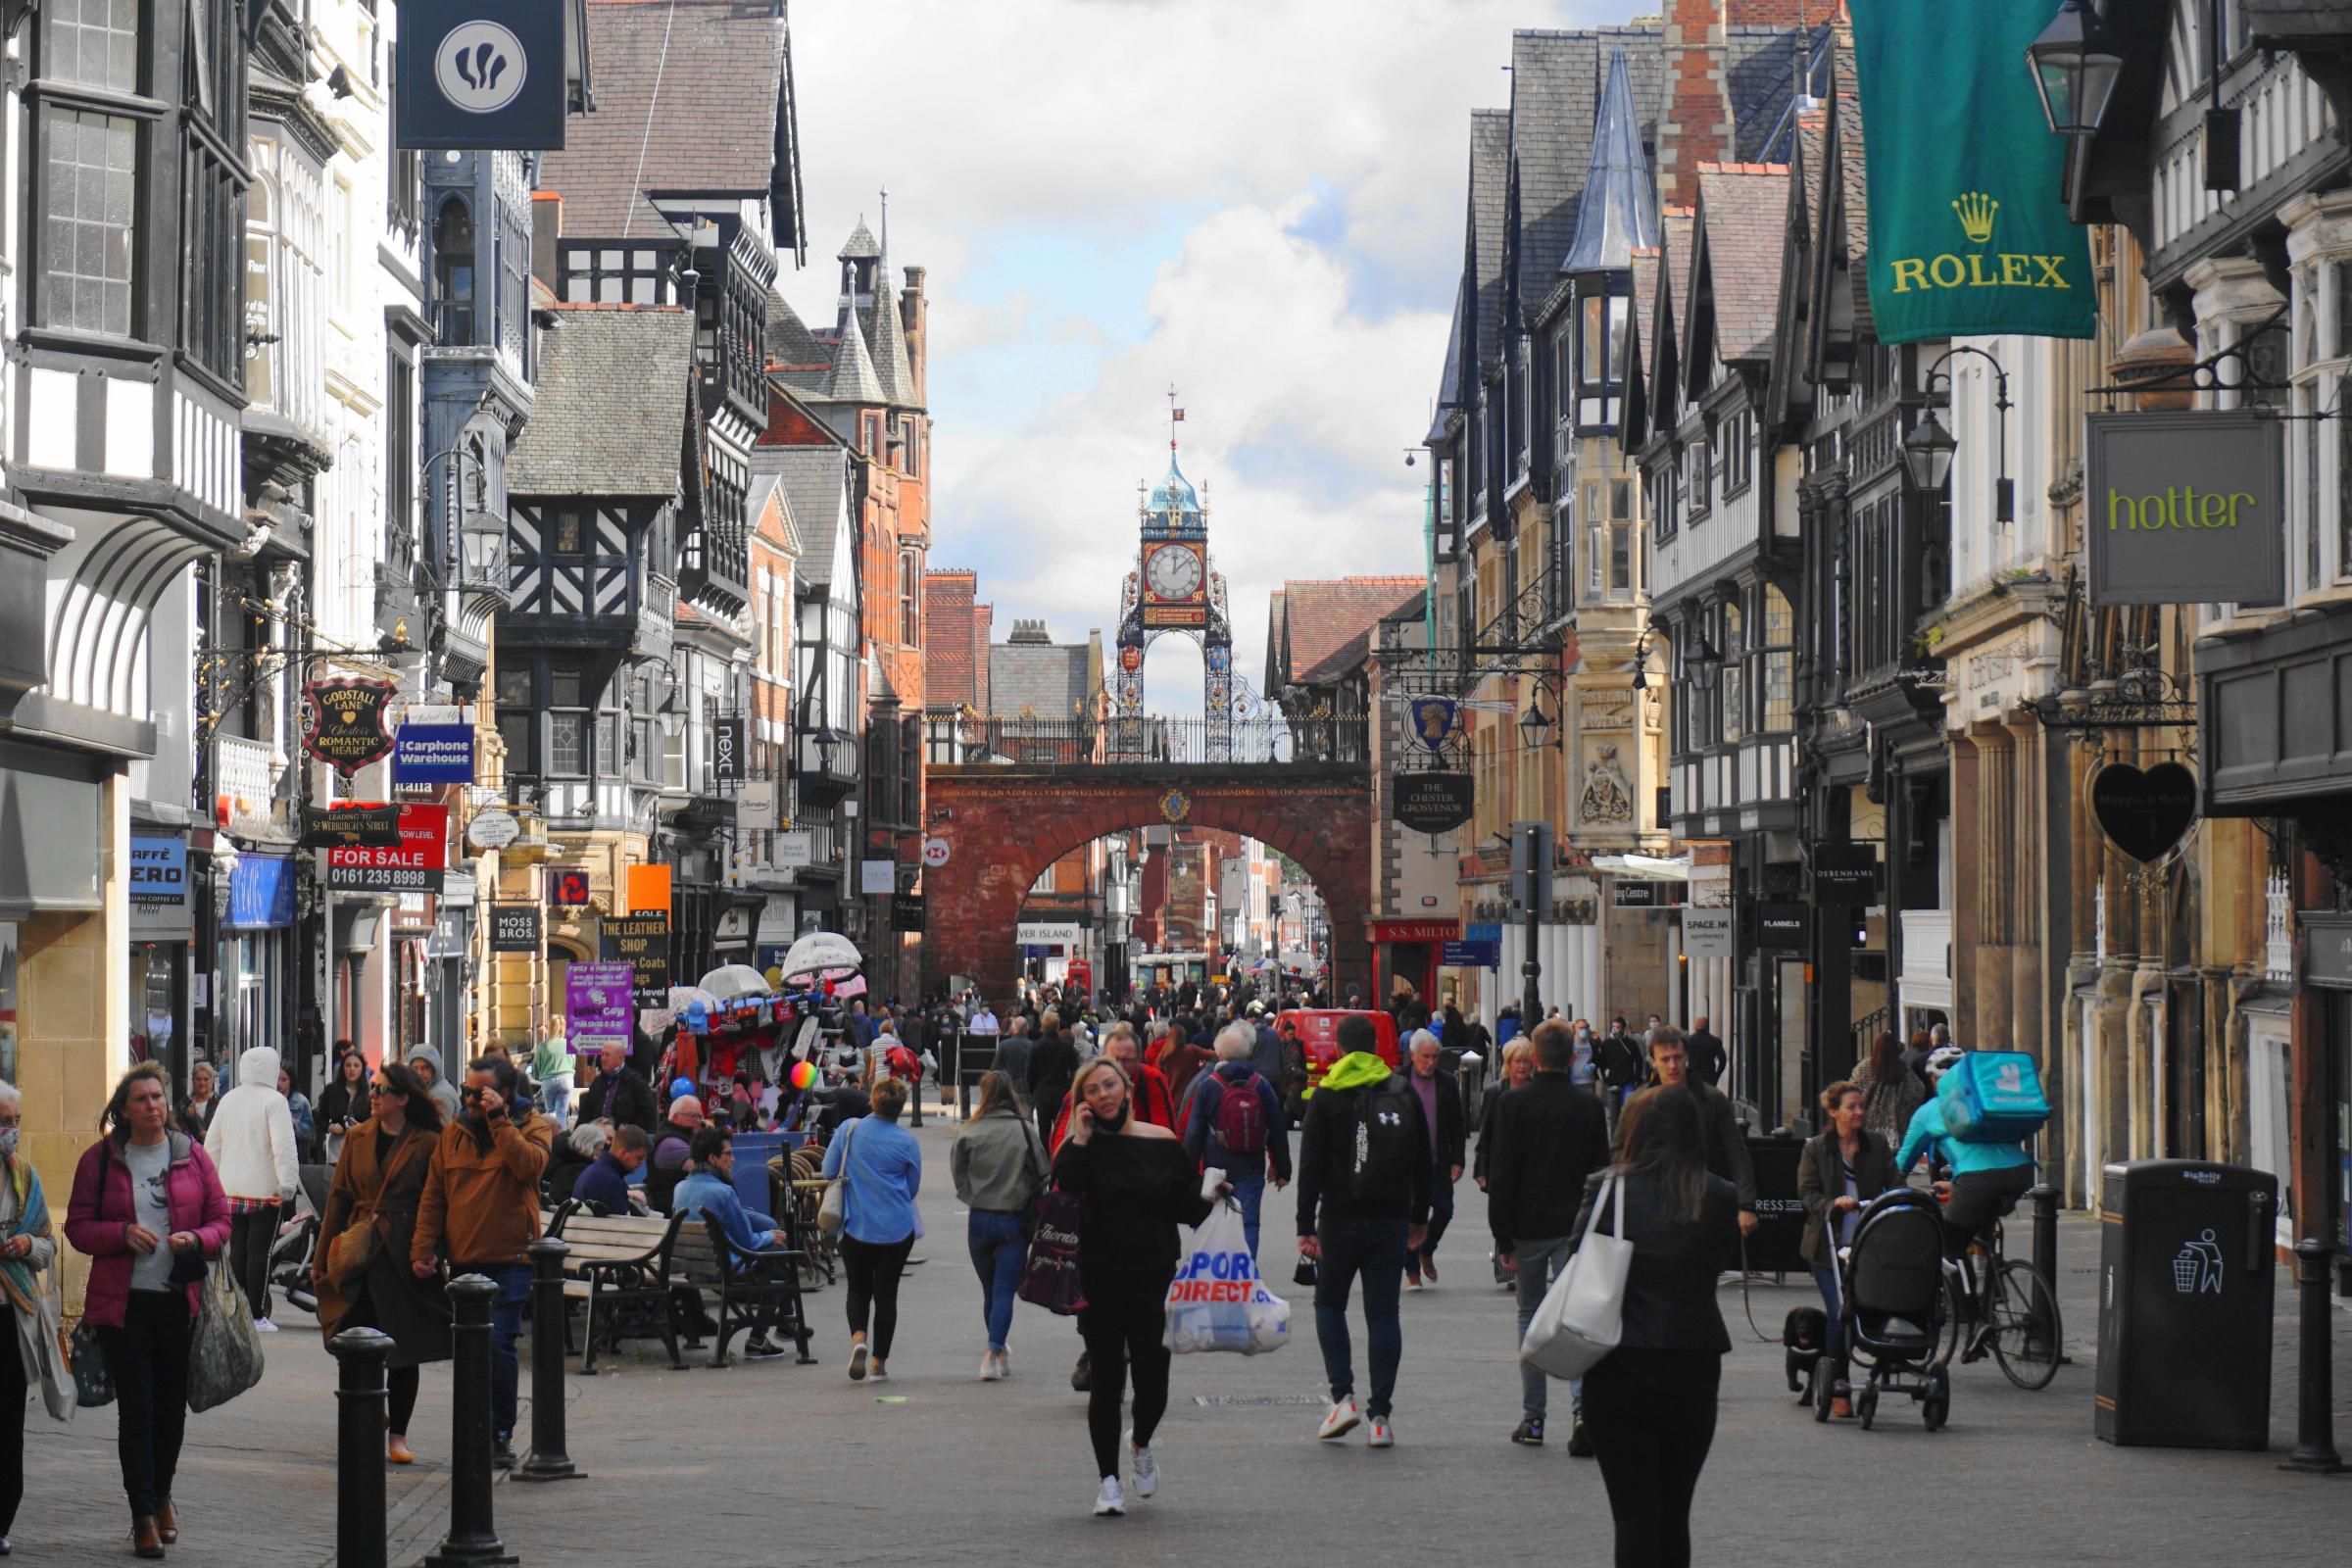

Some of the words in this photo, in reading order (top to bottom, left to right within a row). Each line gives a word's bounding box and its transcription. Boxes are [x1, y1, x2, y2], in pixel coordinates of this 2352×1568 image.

[1890, 253, 2071, 293] ROLEX
[2109, 486, 2256, 530] hotter
[1145, 591, 1156, 602] 18
[1192, 590, 1204, 602] 97
[322, 689, 375, 706] GODSTALL
[334, 701, 364, 710] LANE
[318, 736, 379, 746] ROMANTIC
[406, 740, 469, 753] Carphone
[331, 746, 367, 755] HEART
[718, 725, 733, 774] next
[400, 753, 469, 763] Warehouse
[1423, 783, 1443, 792] THE
[1410, 793, 1454, 802] CHESTER
[1402, 804, 1462, 812] GROSVENOR
[131, 848, 171, 859] AFFÈ
[333, 850, 370, 864] FOR
[376, 852, 424, 866] SALE
[129, 866, 181, 883] ERO
[332, 868, 364, 883] 0161
[367, 869, 391, 884] 235
[393, 870, 425, 885] 8998
[1625, 887, 1649, 898] Centre
[499, 916, 533, 927] MOSS
[603, 922, 620, 936] THE
[623, 921, 665, 935] LEATHER
[1019, 929, 1036, 938] VER
[1040, 929, 1073, 938] ISLAND
[620, 939, 648, 952] SHOP
[640, 956, 666, 968] Coats
[635, 973, 651, 985] ags
[642, 987, 665, 997] level
[1755, 1199, 1785, 1210] RESS
